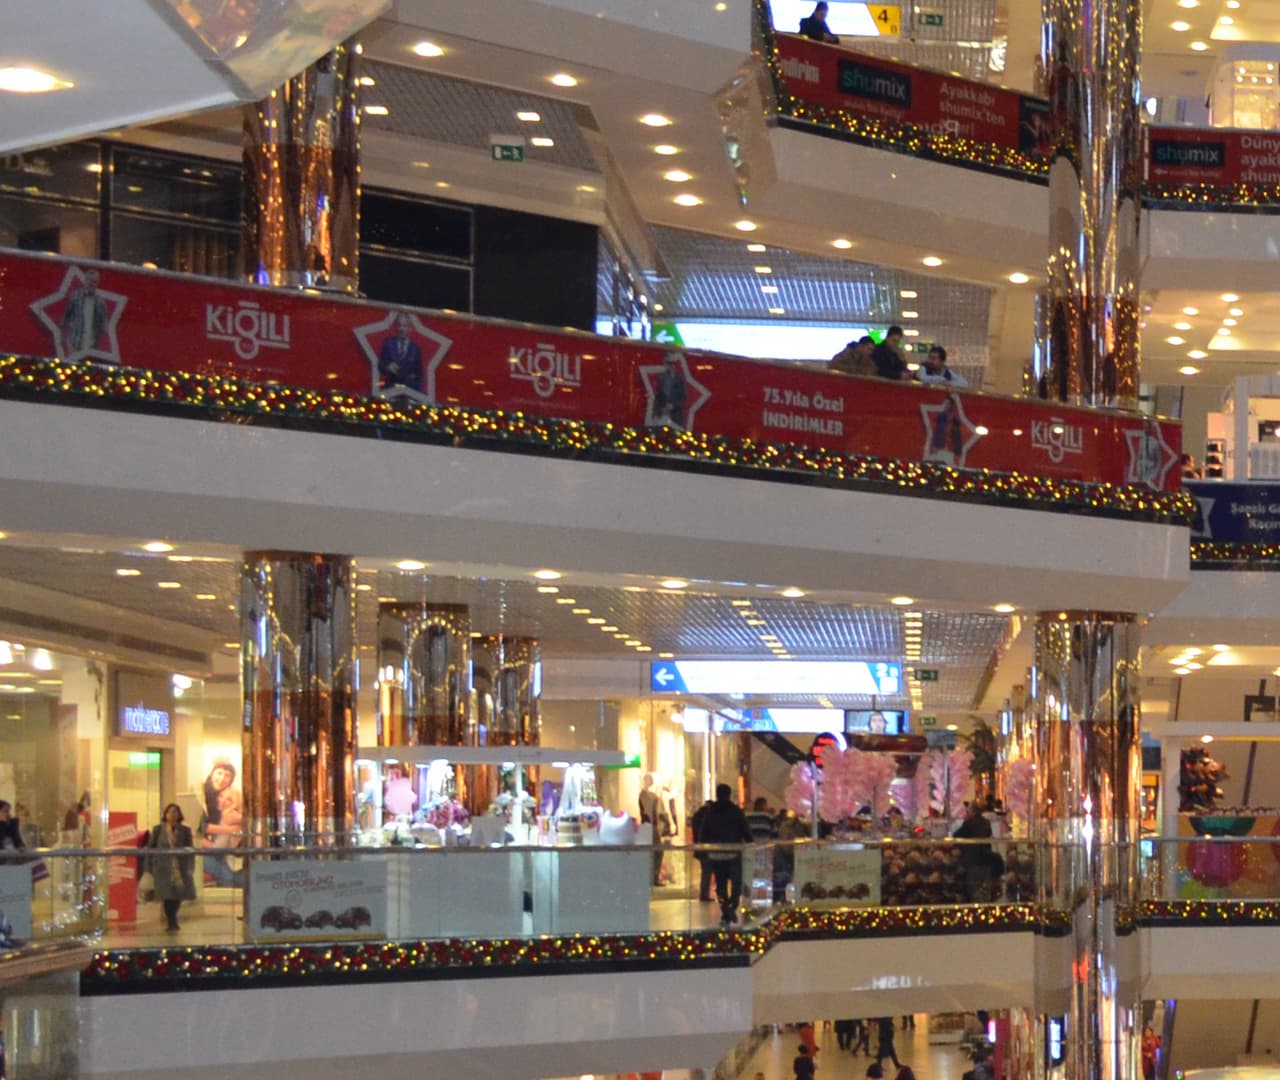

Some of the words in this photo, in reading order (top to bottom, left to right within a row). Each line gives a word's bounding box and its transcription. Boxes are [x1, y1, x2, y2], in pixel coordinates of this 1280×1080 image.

[877, 9, 889, 24] 4
[842, 68, 907, 100] shumix
[1155, 146, 1219, 163] shumix
[813, 390, 844, 413] Özel
